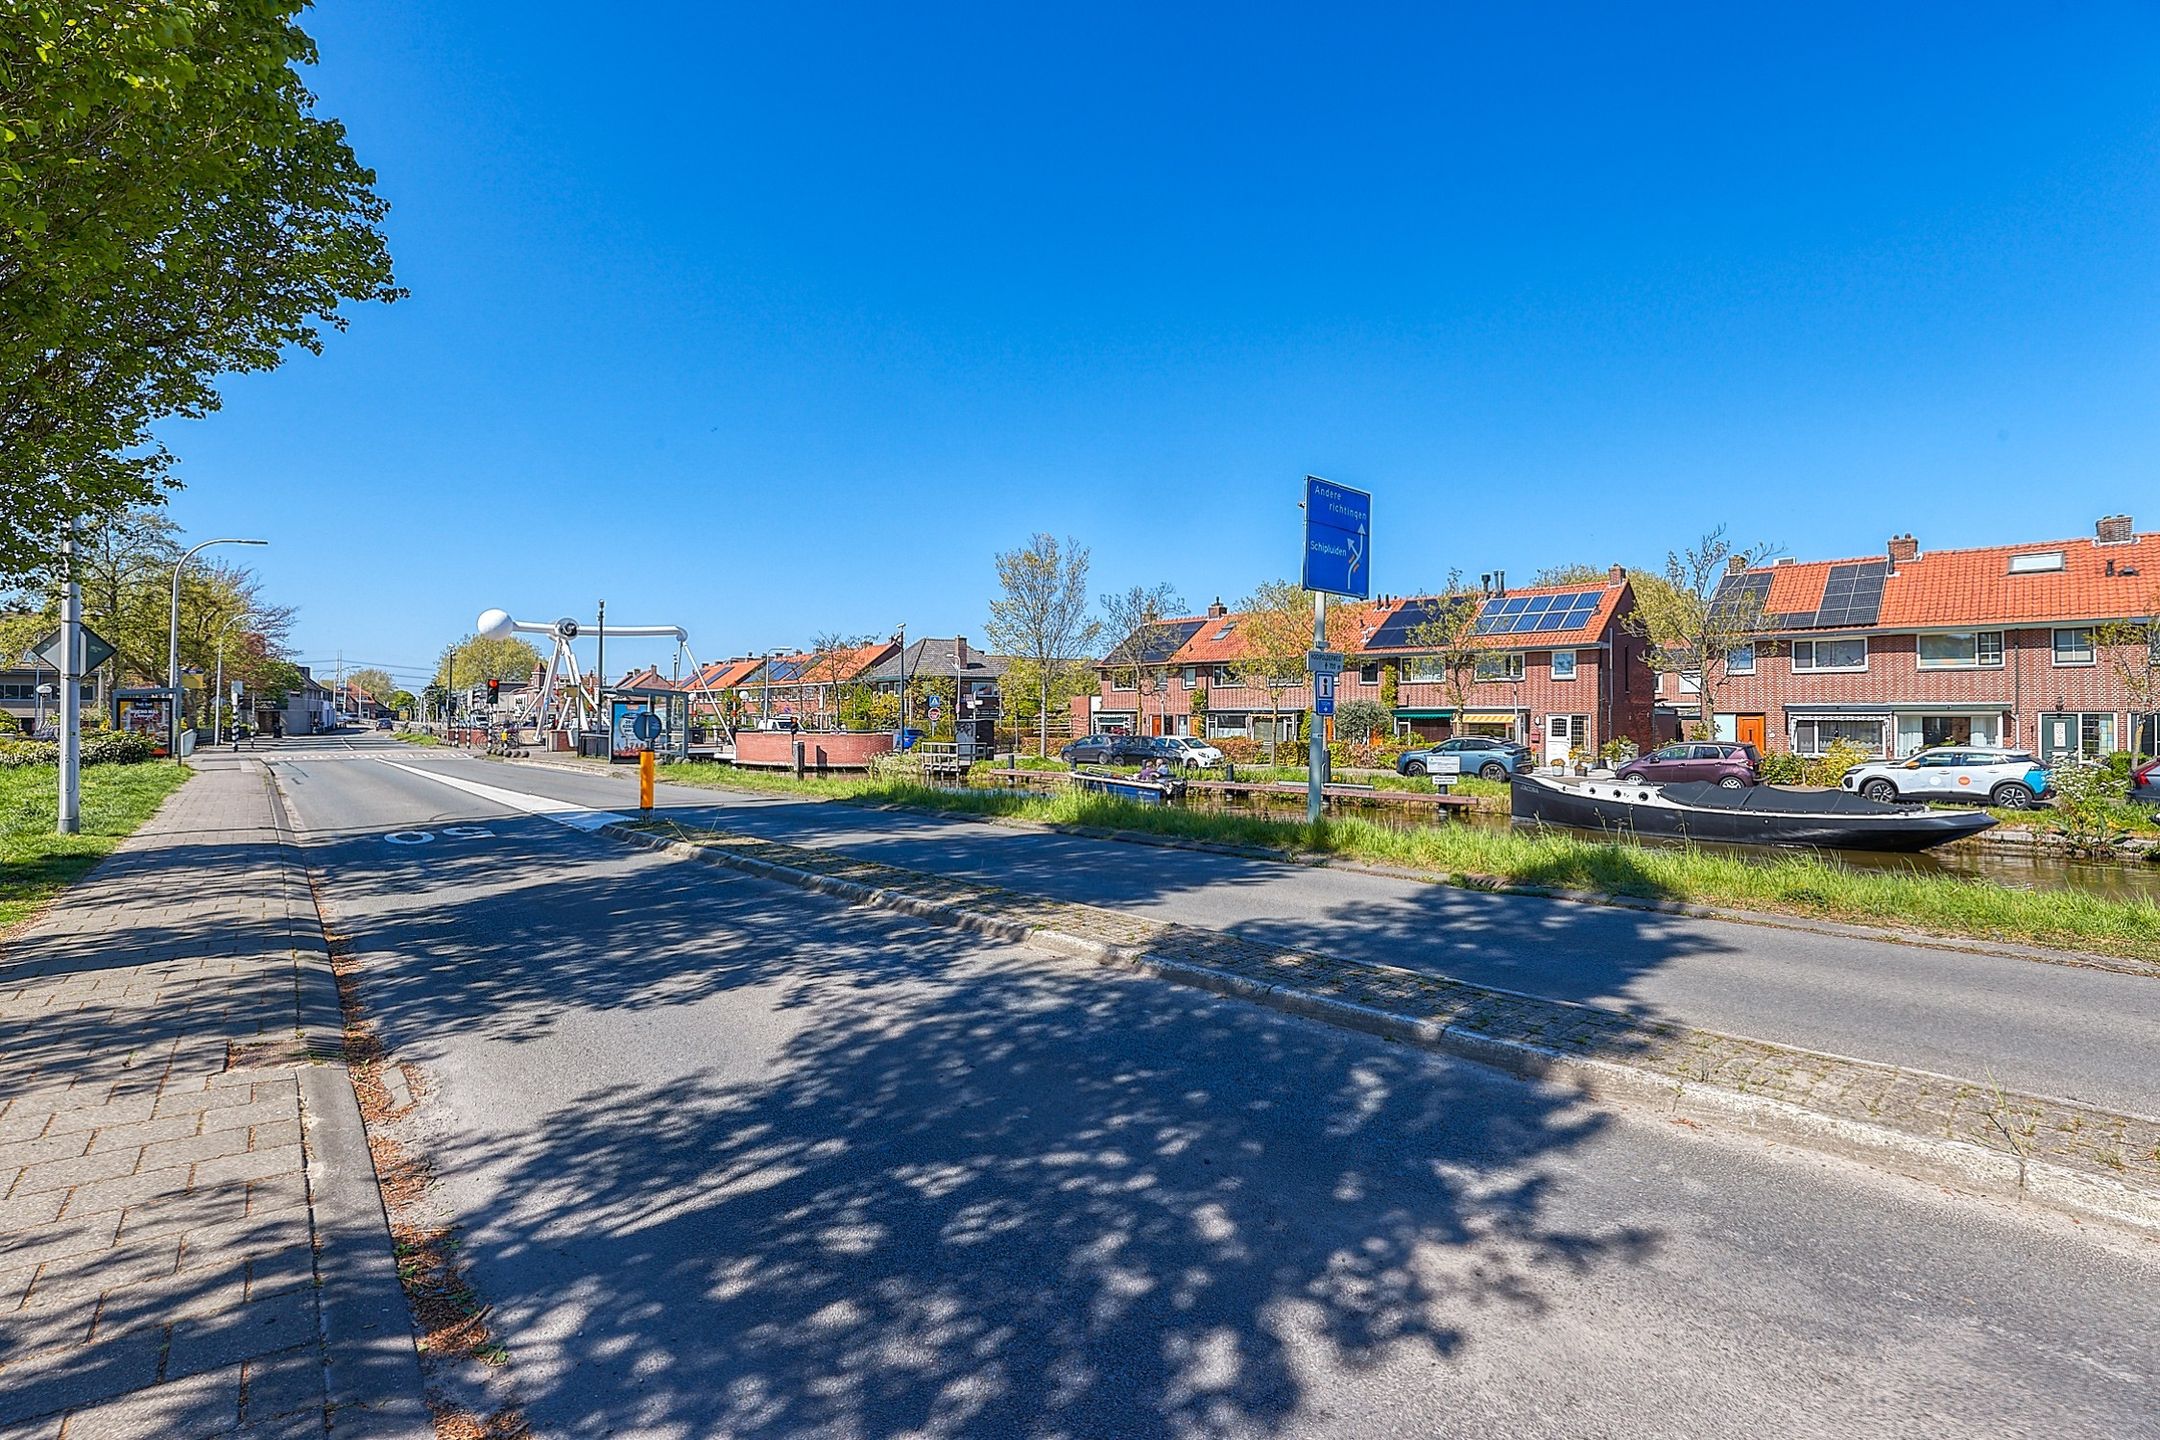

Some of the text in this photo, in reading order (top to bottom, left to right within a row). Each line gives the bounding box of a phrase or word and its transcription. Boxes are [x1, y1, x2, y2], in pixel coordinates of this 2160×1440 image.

[1315, 485, 1342, 501] Andere
[1328, 502, 1367, 521] richtingen
[1310, 540, 1347, 557] Schipluiden
